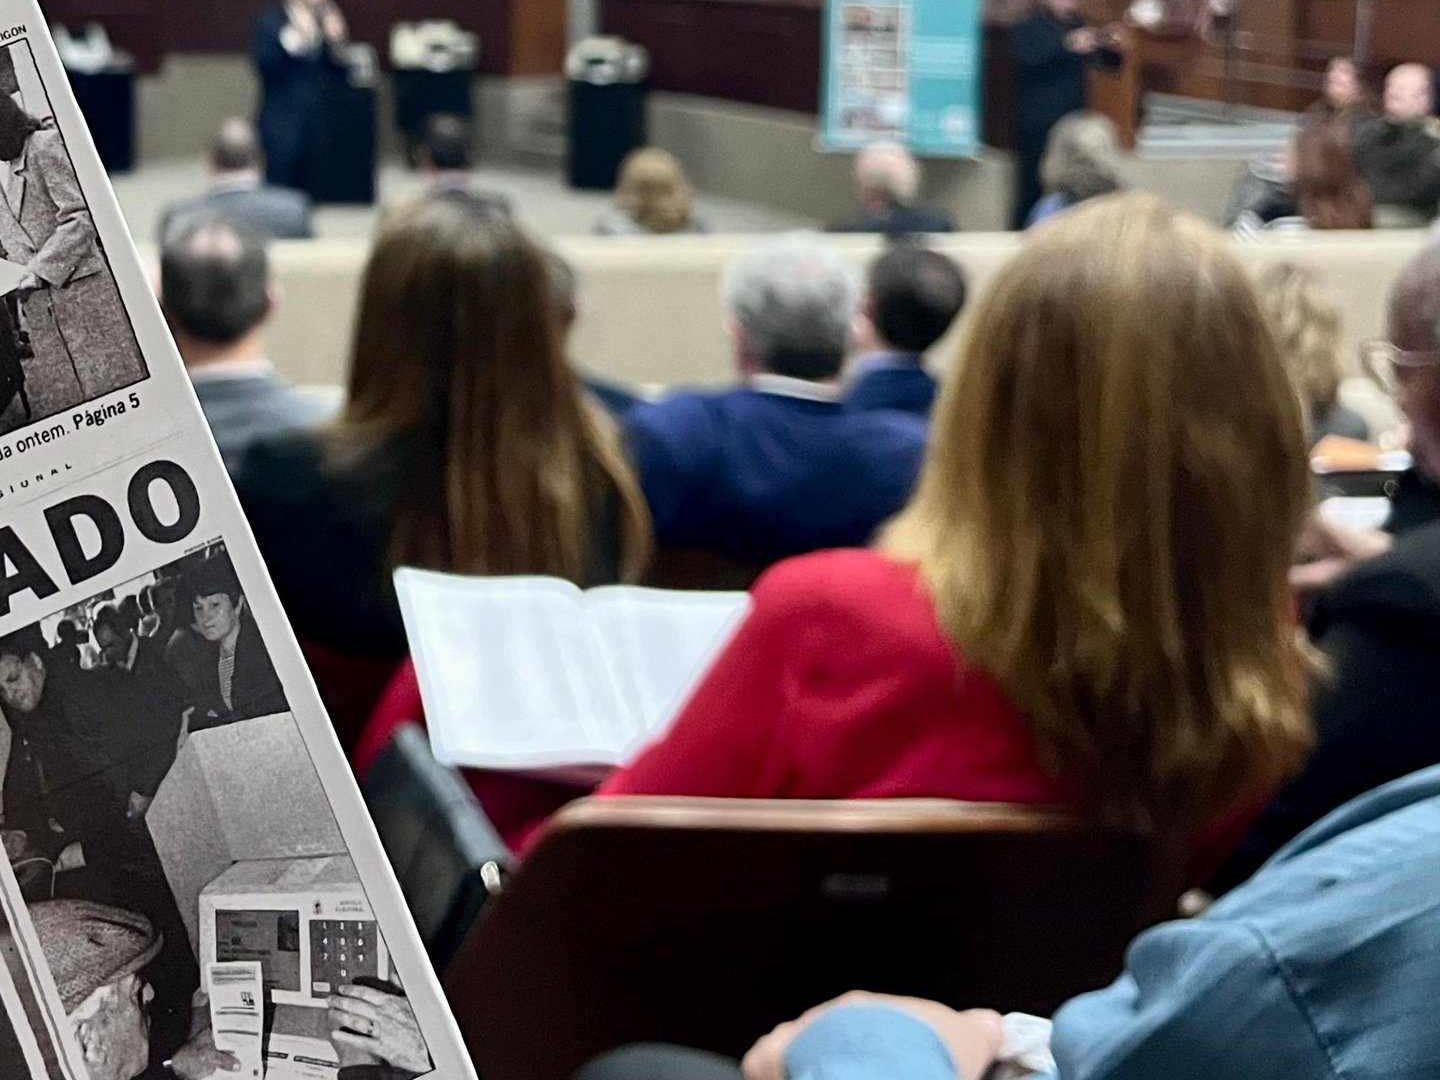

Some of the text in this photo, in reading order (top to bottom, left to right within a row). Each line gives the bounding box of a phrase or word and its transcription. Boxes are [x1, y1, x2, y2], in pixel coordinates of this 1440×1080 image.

[16, 424, 70, 453] ontem.
[72, 401, 126, 430] Página
[128, 392, 140, 409] 5
